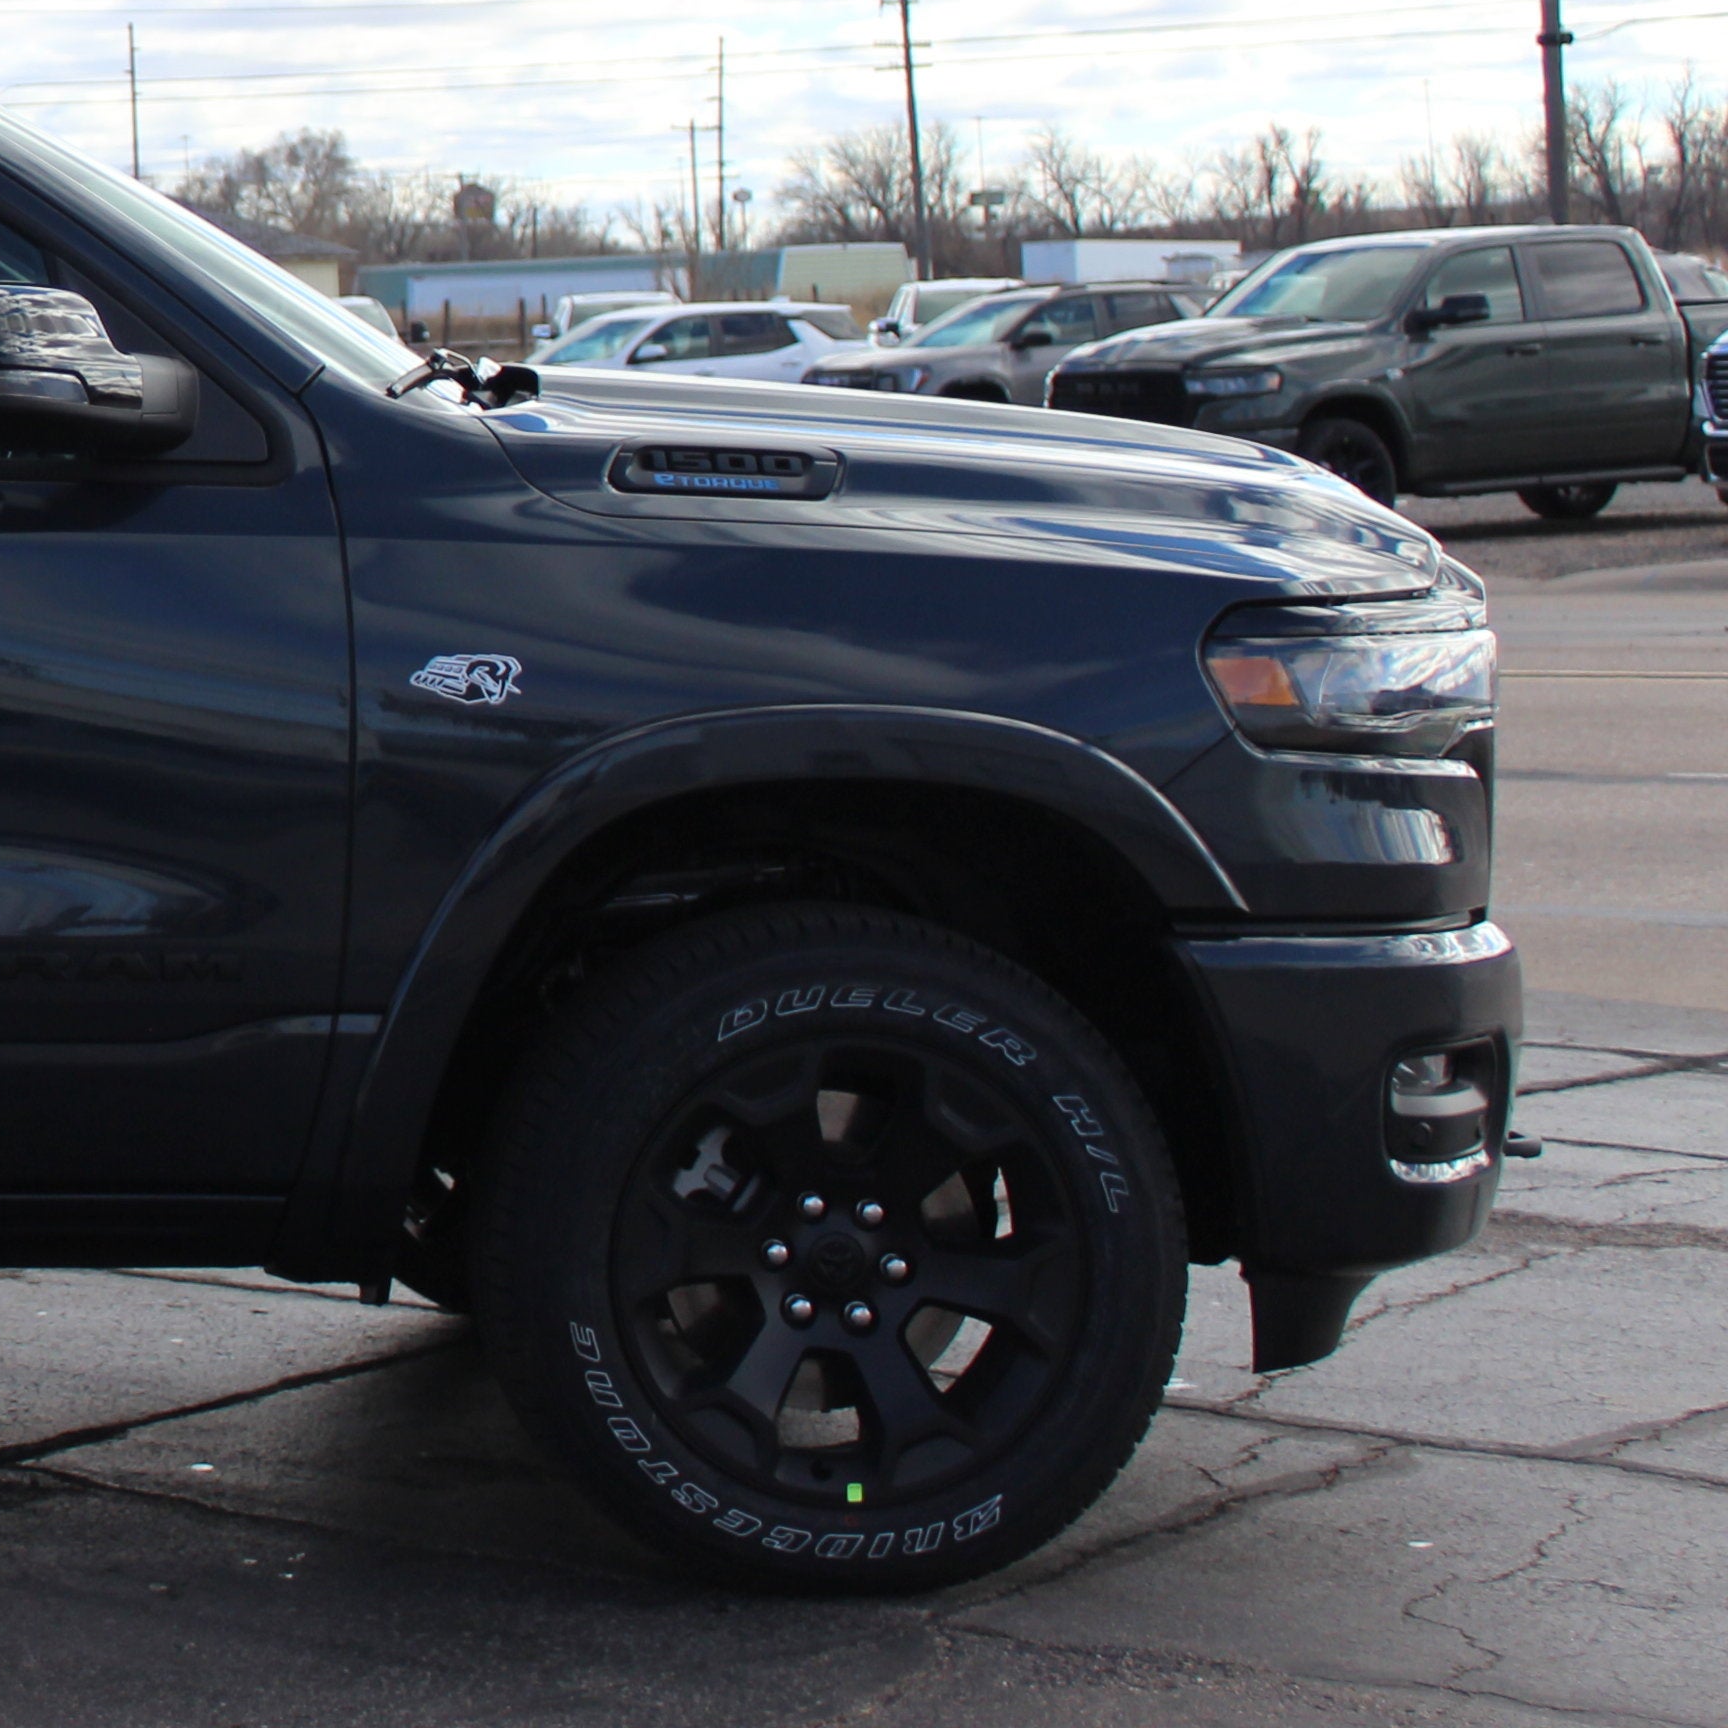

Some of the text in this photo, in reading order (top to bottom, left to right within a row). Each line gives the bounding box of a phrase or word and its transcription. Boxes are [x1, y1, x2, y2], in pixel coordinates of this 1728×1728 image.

[648, 449, 804, 475] 1500
[717, 984, 1130, 1214] DUELER H/L
[570, 1320, 1003, 1560] BRIDGESTONE
